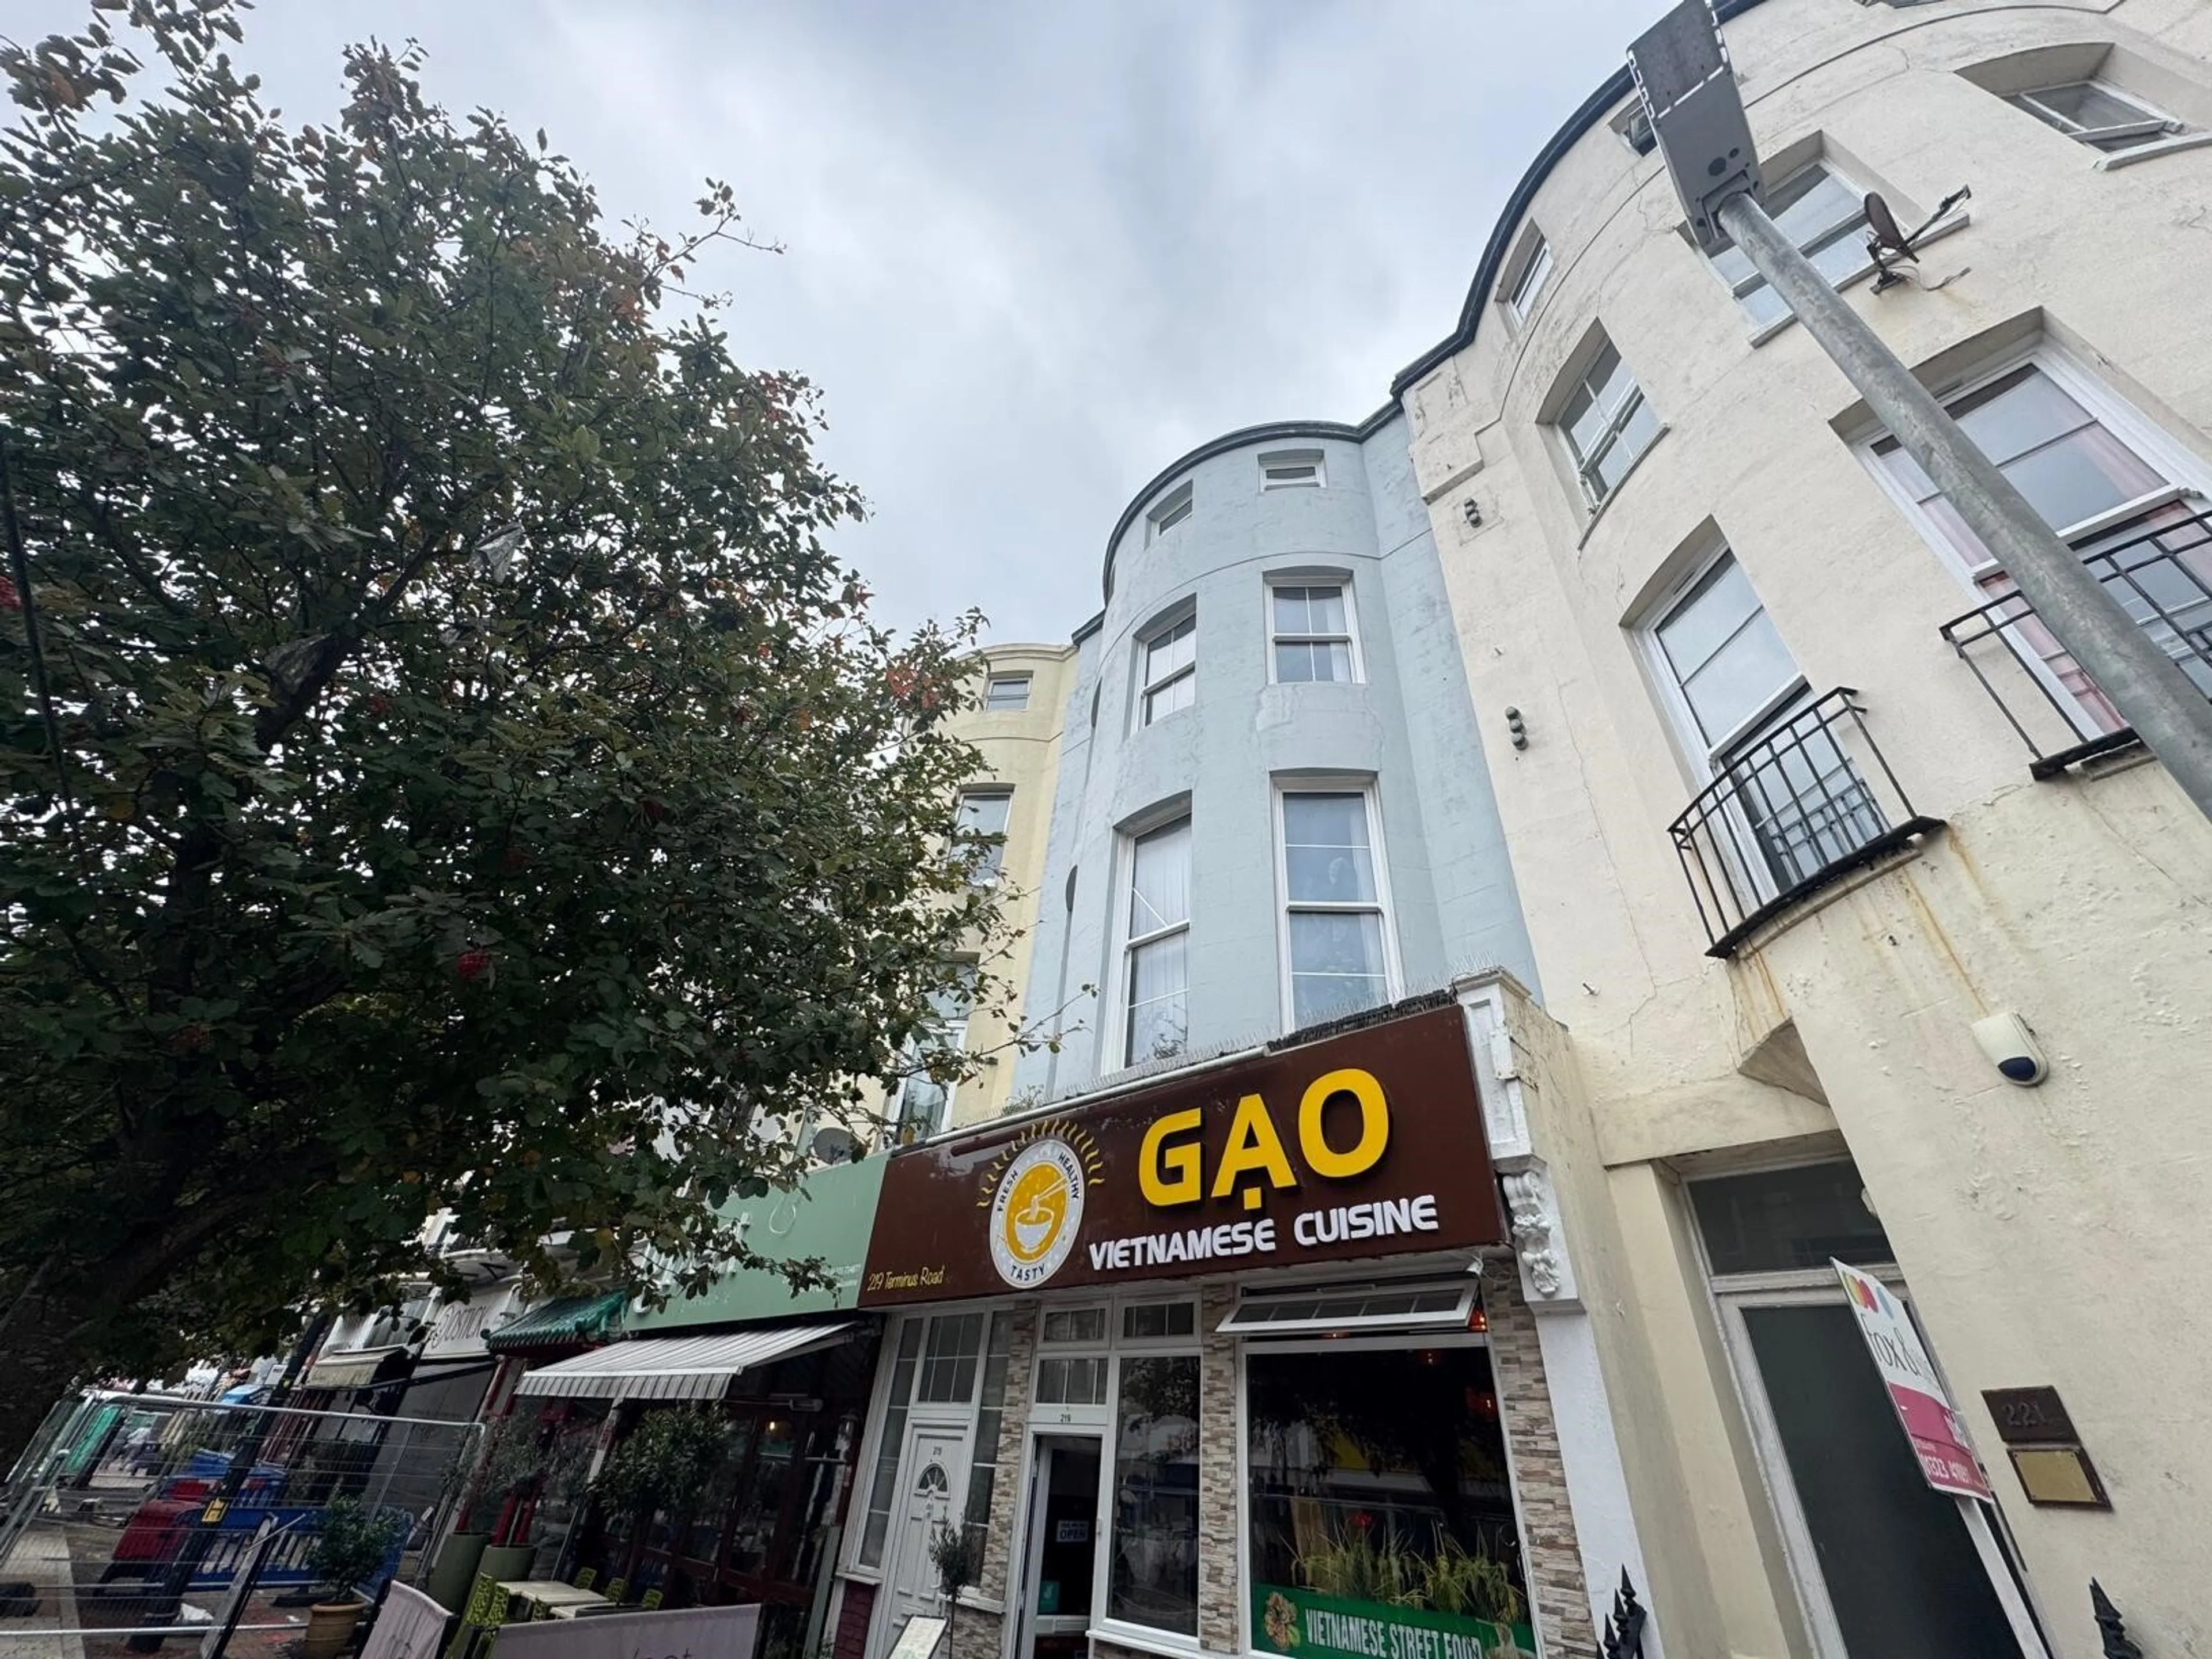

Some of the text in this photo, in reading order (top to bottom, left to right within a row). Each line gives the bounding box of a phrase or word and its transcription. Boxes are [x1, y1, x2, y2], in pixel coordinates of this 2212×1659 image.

[997, 1171, 1019, 1212] FRESH
[1058, 1152, 1080, 1200] HEALTHY
[1089, 1194, 1439, 1270] VIETNAMESE CUISINE
[866, 1272, 884, 1291] 219
[885, 1271, 919, 1289] Terminus
[920, 1263, 945, 1286] Road
[1010, 1264, 1046, 1282] TASTY
[2002, 1401, 2048, 1427] 221
[1305, 1608, 1387, 1658] VIETNAMESE
[1389, 1623, 1440, 1659] STREET
